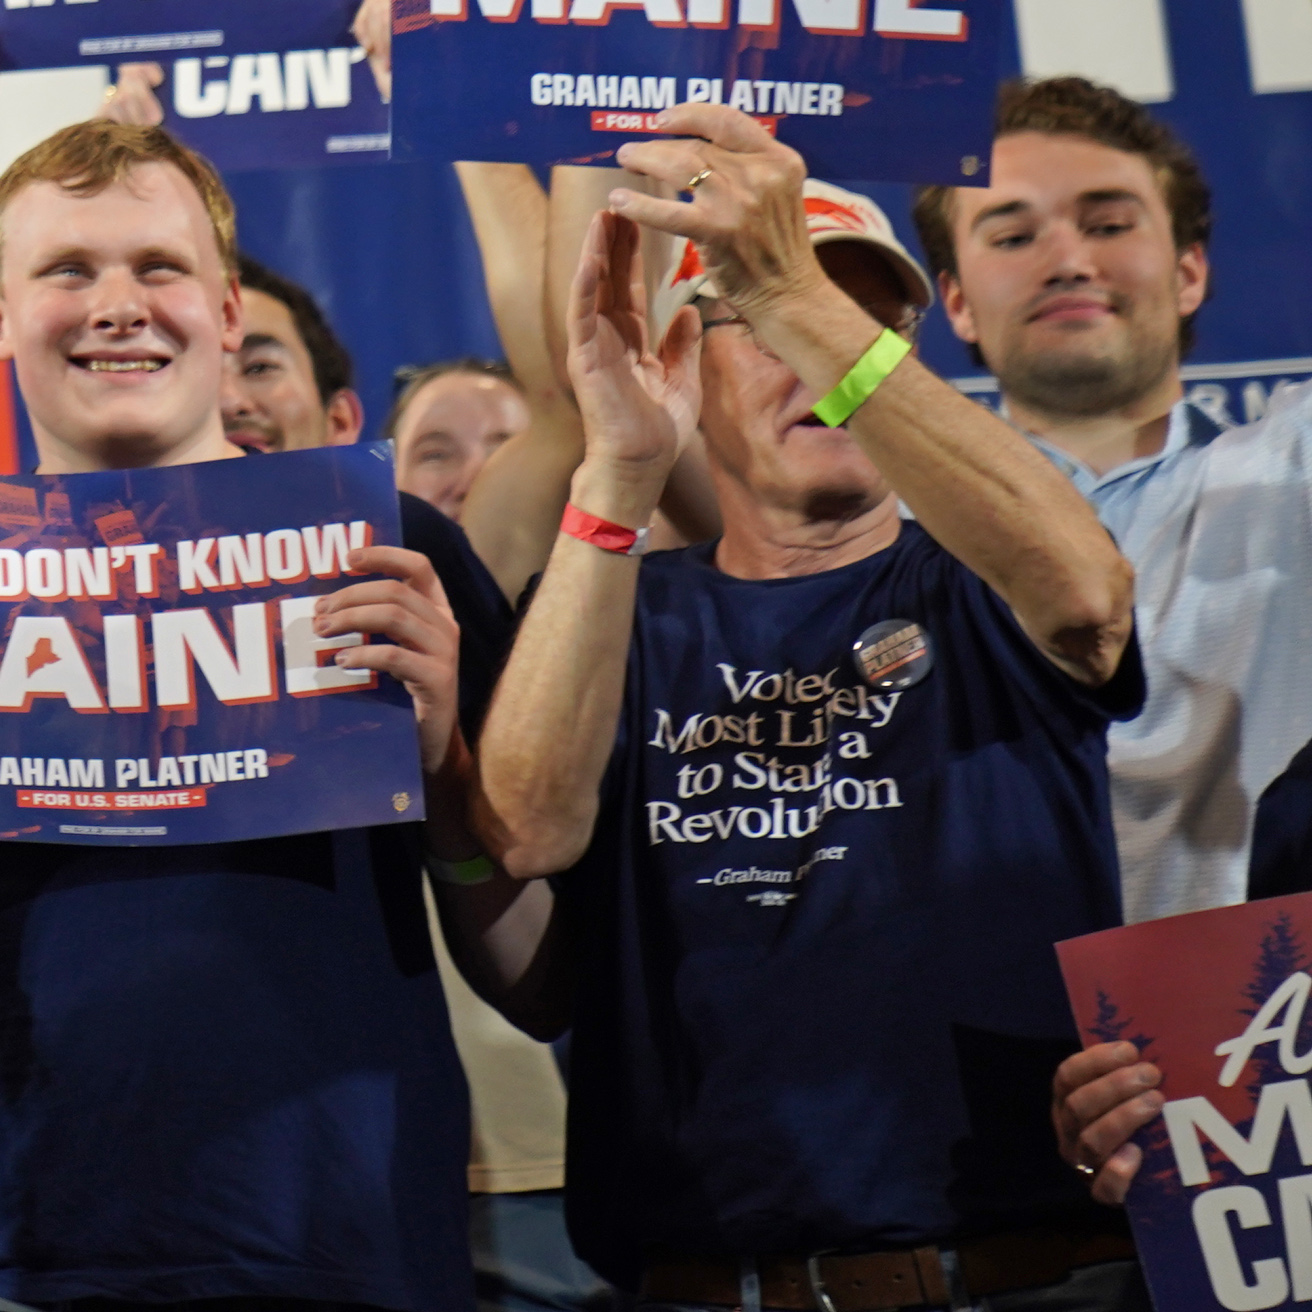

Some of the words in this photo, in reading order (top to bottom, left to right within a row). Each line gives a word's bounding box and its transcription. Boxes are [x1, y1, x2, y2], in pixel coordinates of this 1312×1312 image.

[174, 46, 368, 118] CAN'
[531, 72, 676, 109] GRAHAM
[686, 77, 845, 116] PLATNER
[606, 113, 642, 130] FOR
[177, 520, 370, 592] KNOW
[648, 708, 765, 754] Most
[115, 748, 270, 788] PLATNER
[677, 763, 724, 799] to
[838, 730, 873, 760] a
[33, 791, 71, 806] FOR
[75, 793, 111, 808] U.S.
[114, 791, 191, 808] SENATE
[1214, 971, 1312, 1088] A
